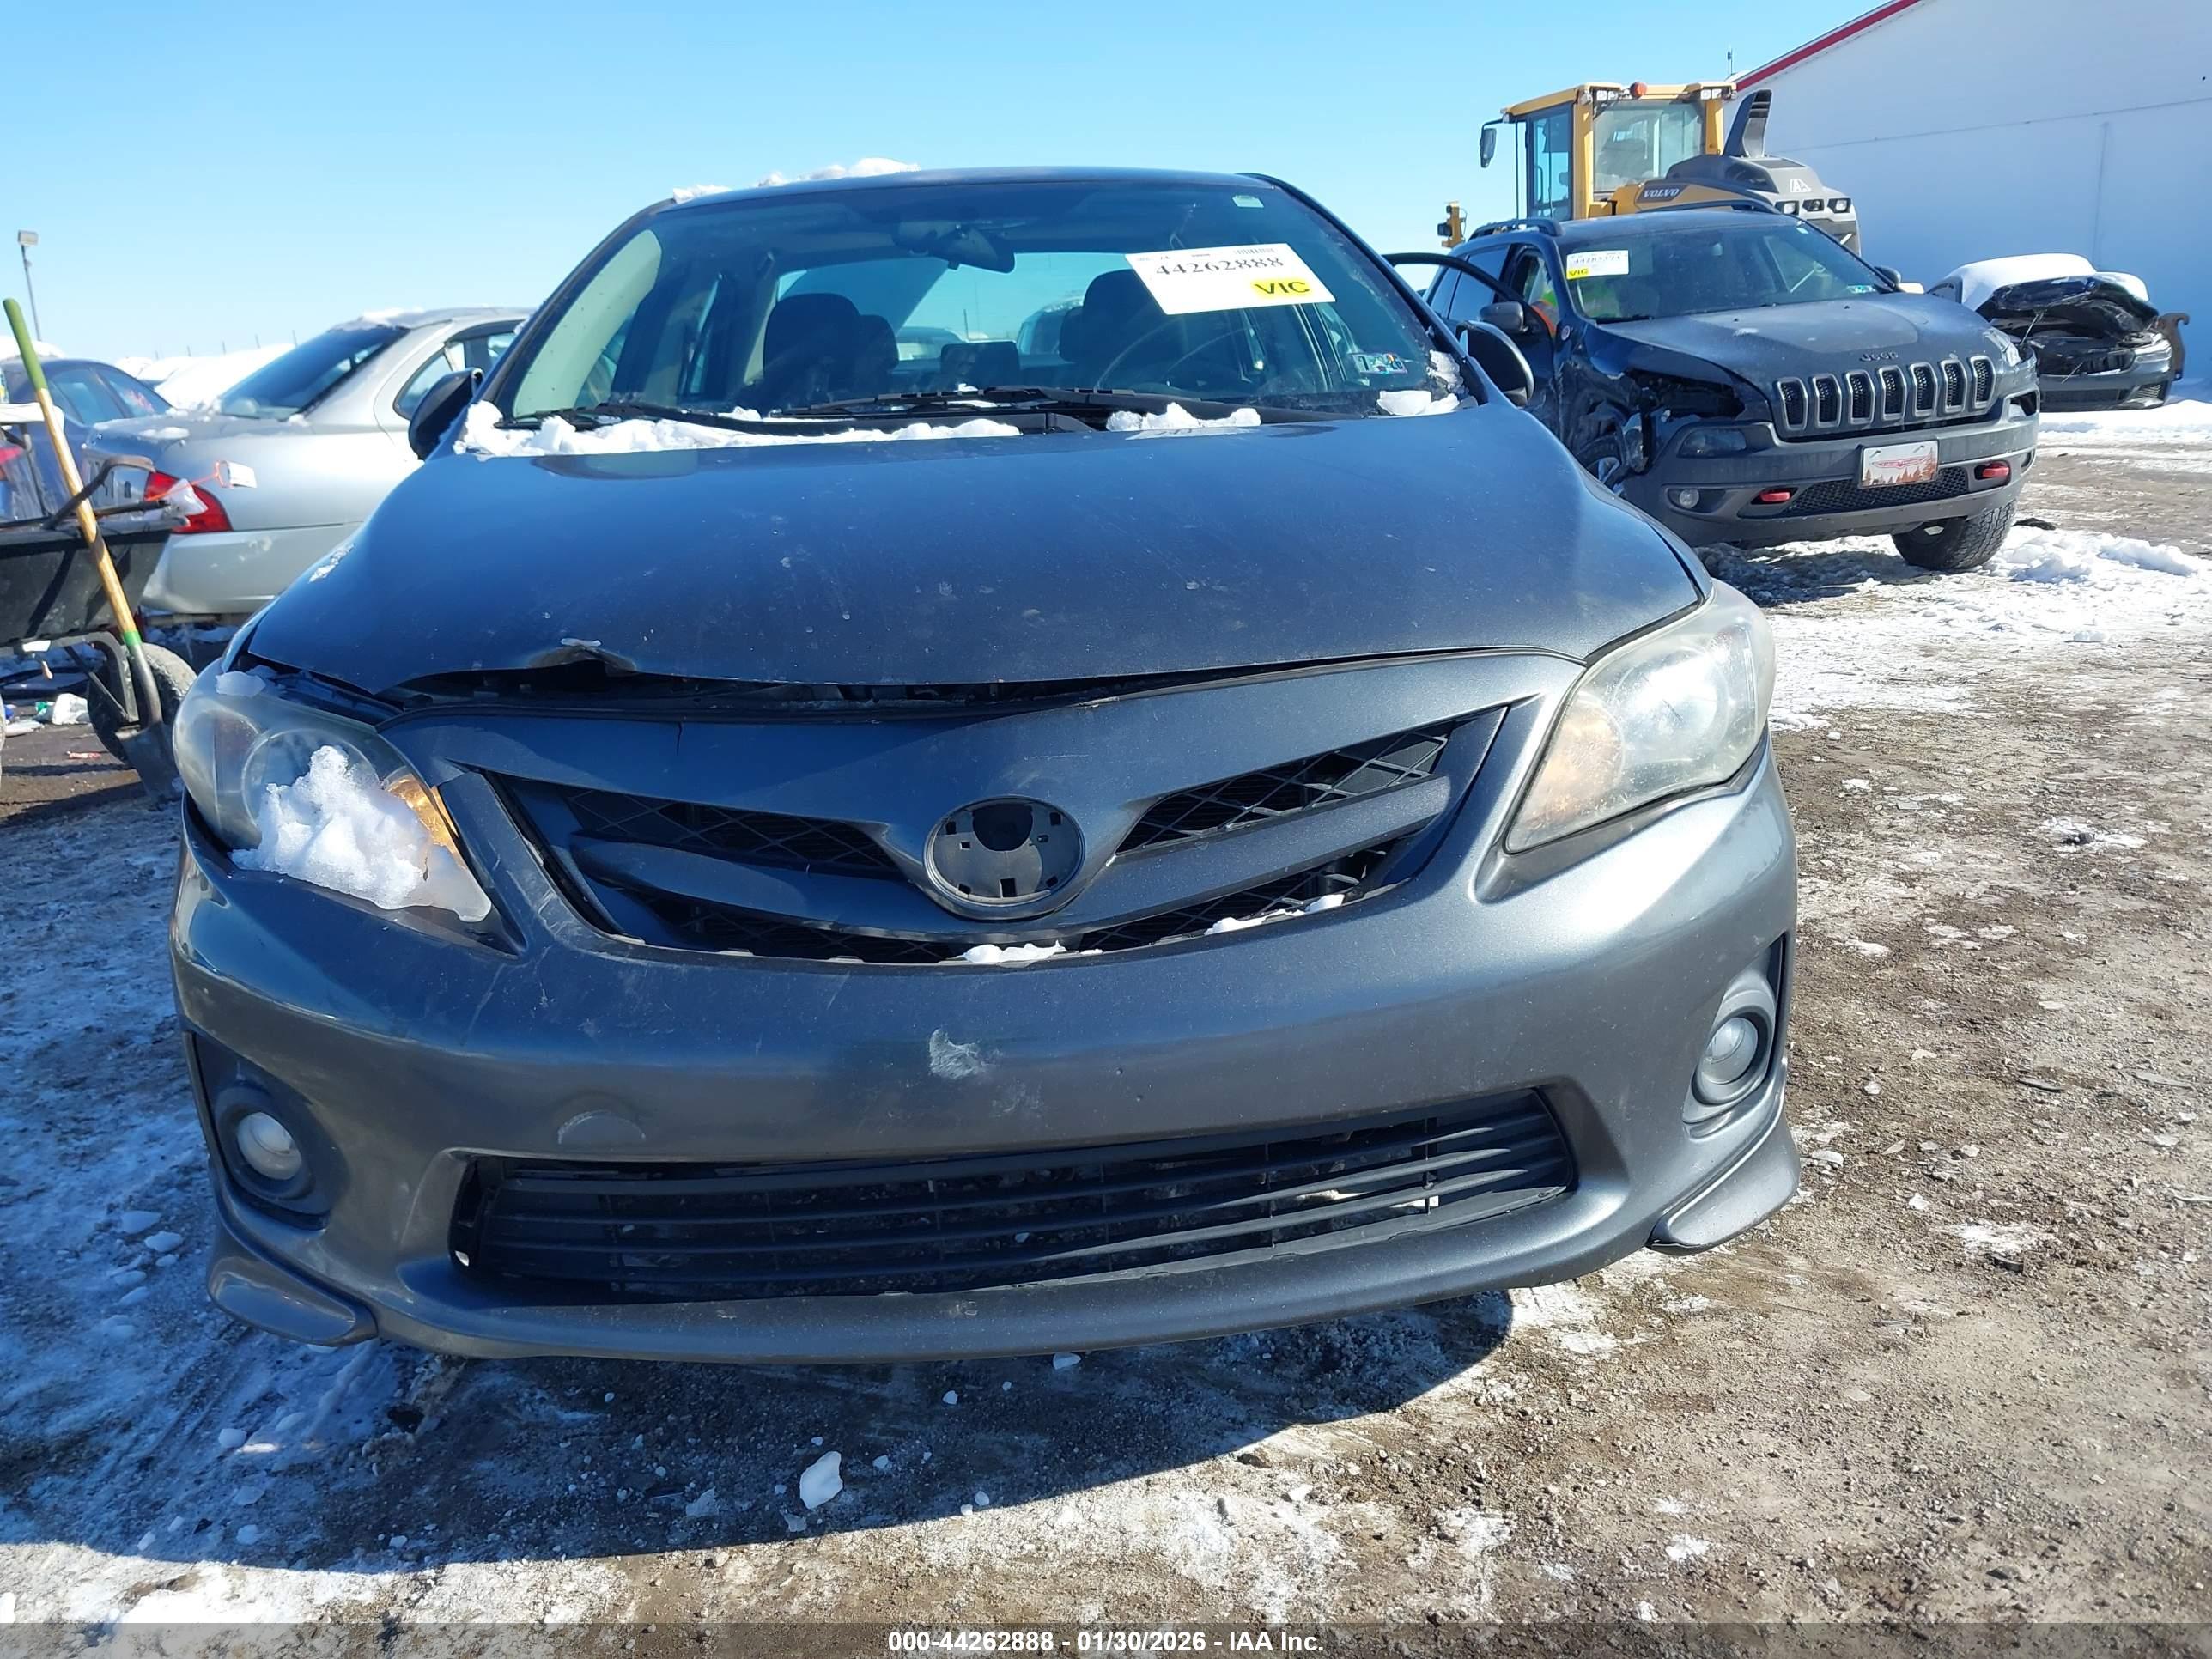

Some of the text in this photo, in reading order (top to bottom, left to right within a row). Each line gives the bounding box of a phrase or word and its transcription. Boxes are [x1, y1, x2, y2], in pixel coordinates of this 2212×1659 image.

[1643, 187, 1680, 198] VOLVO
[1156, 256, 1285, 276] 44262888
[1254, 281, 1310, 295] VIC
[1858, 350, 1899, 362] Jeep
